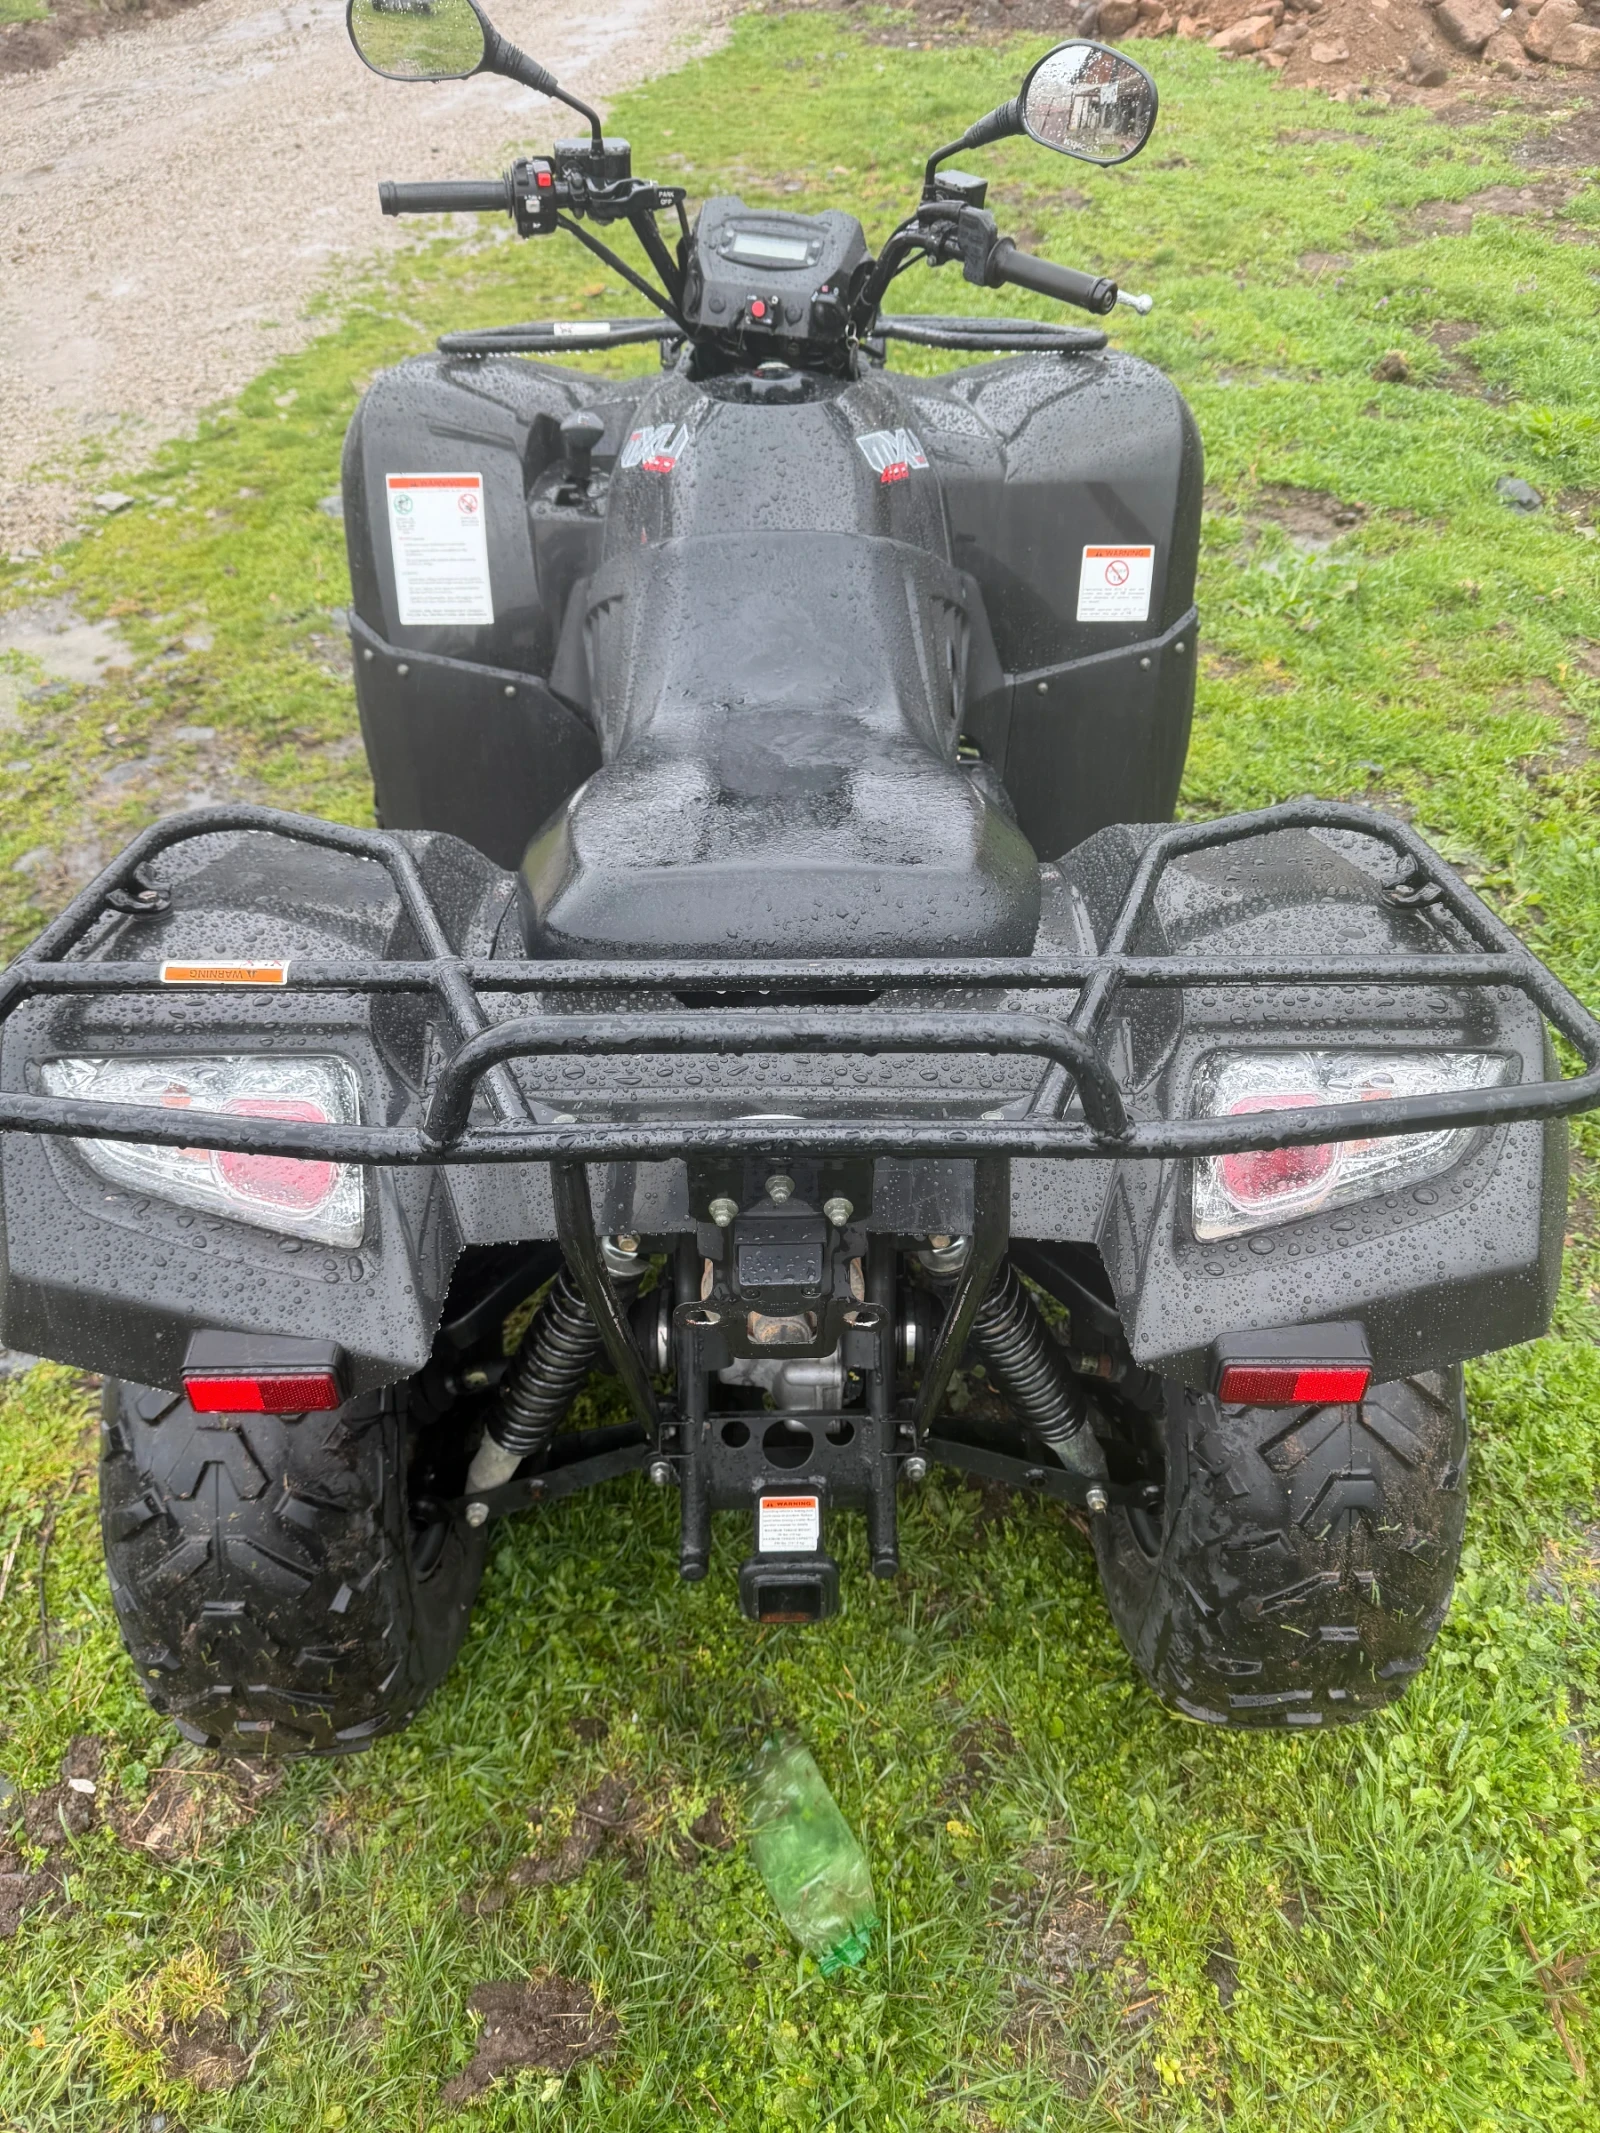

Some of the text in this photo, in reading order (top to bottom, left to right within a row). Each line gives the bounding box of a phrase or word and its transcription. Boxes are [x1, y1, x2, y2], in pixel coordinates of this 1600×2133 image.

[658, 190, 675, 198] PARK
[1105, 549, 1144, 557] WARNING
[189, 969, 244, 979] WARNING
